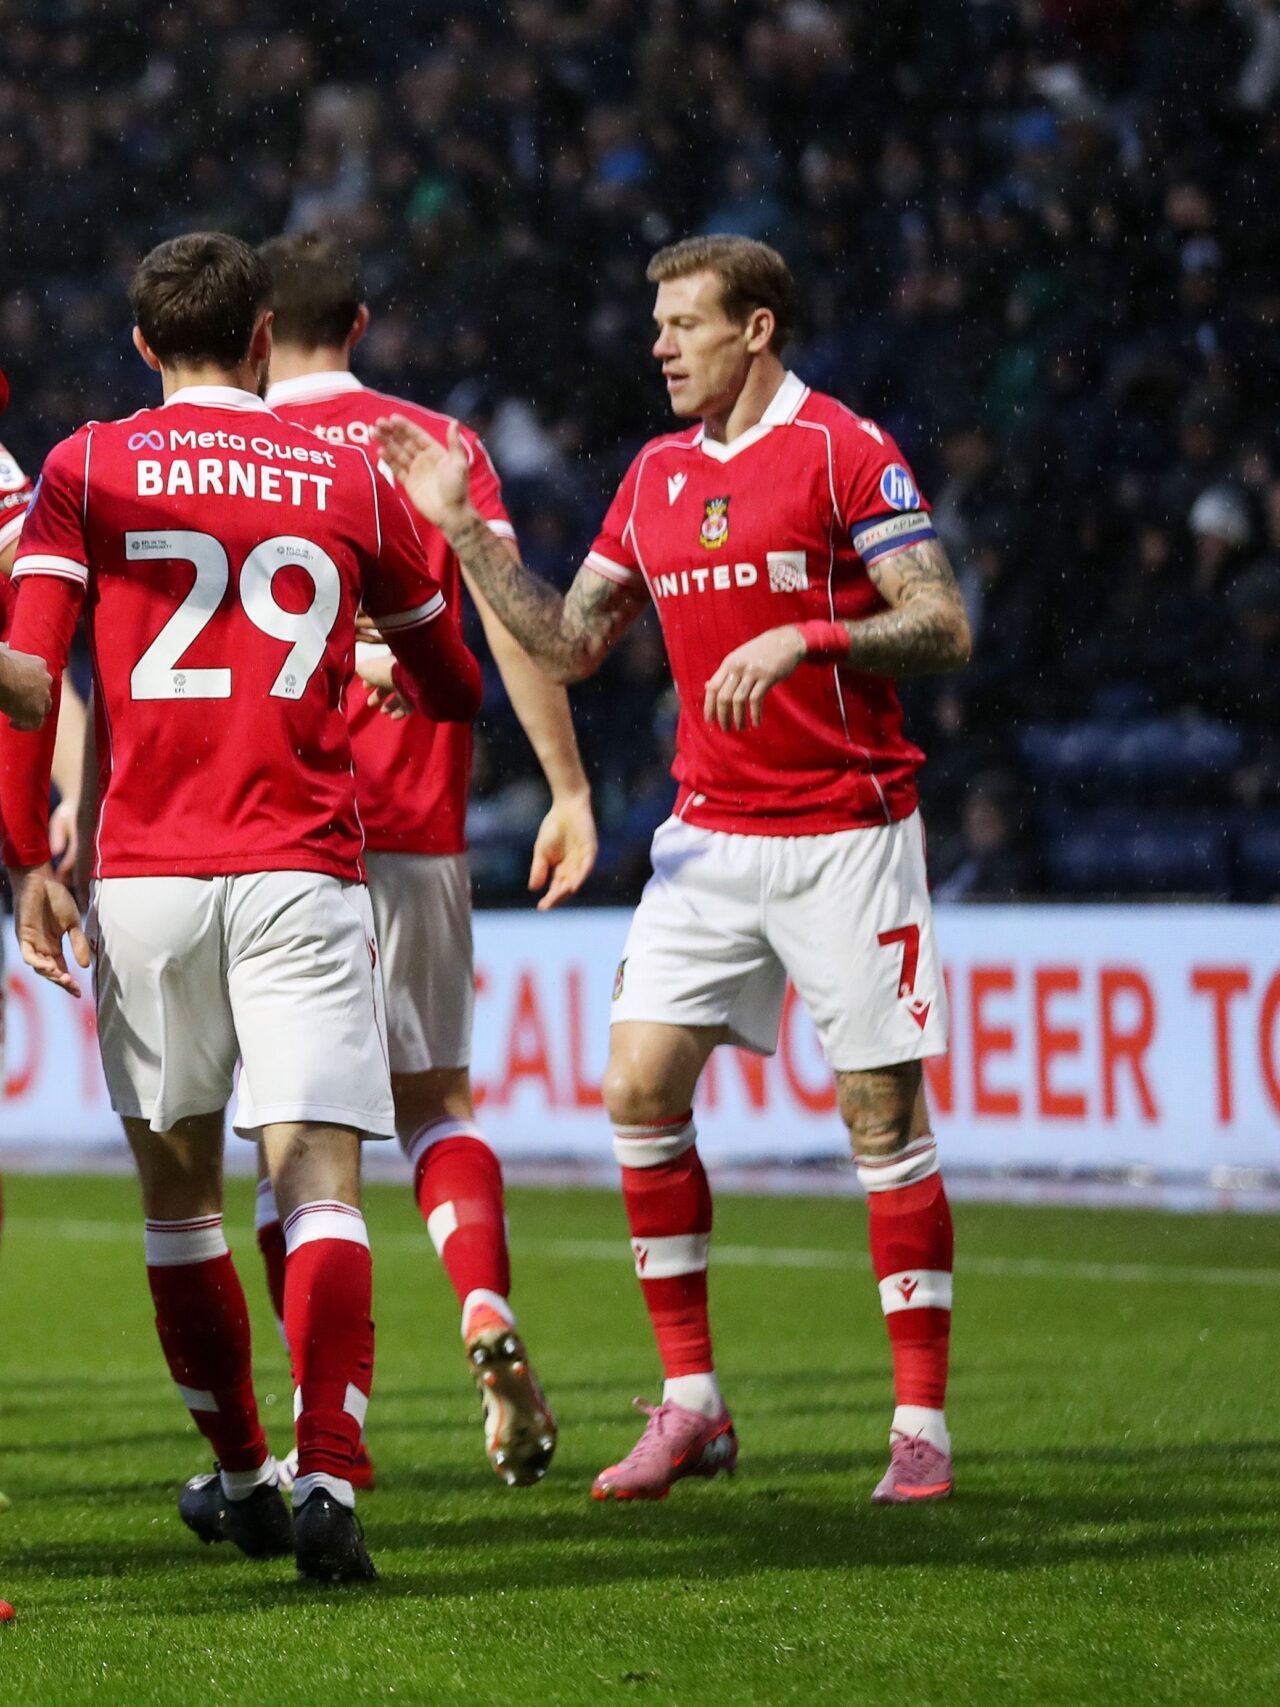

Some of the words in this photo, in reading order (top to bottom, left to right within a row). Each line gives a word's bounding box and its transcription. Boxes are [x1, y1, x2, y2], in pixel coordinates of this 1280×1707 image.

[170, 430, 246, 451] Meta
[251, 437, 337, 468] Quest
[136, 458, 333, 511] BARNETT
[888, 465, 915, 511] hp
[125, 530, 341, 700] 29
[877, 923, 920, 999] 7
